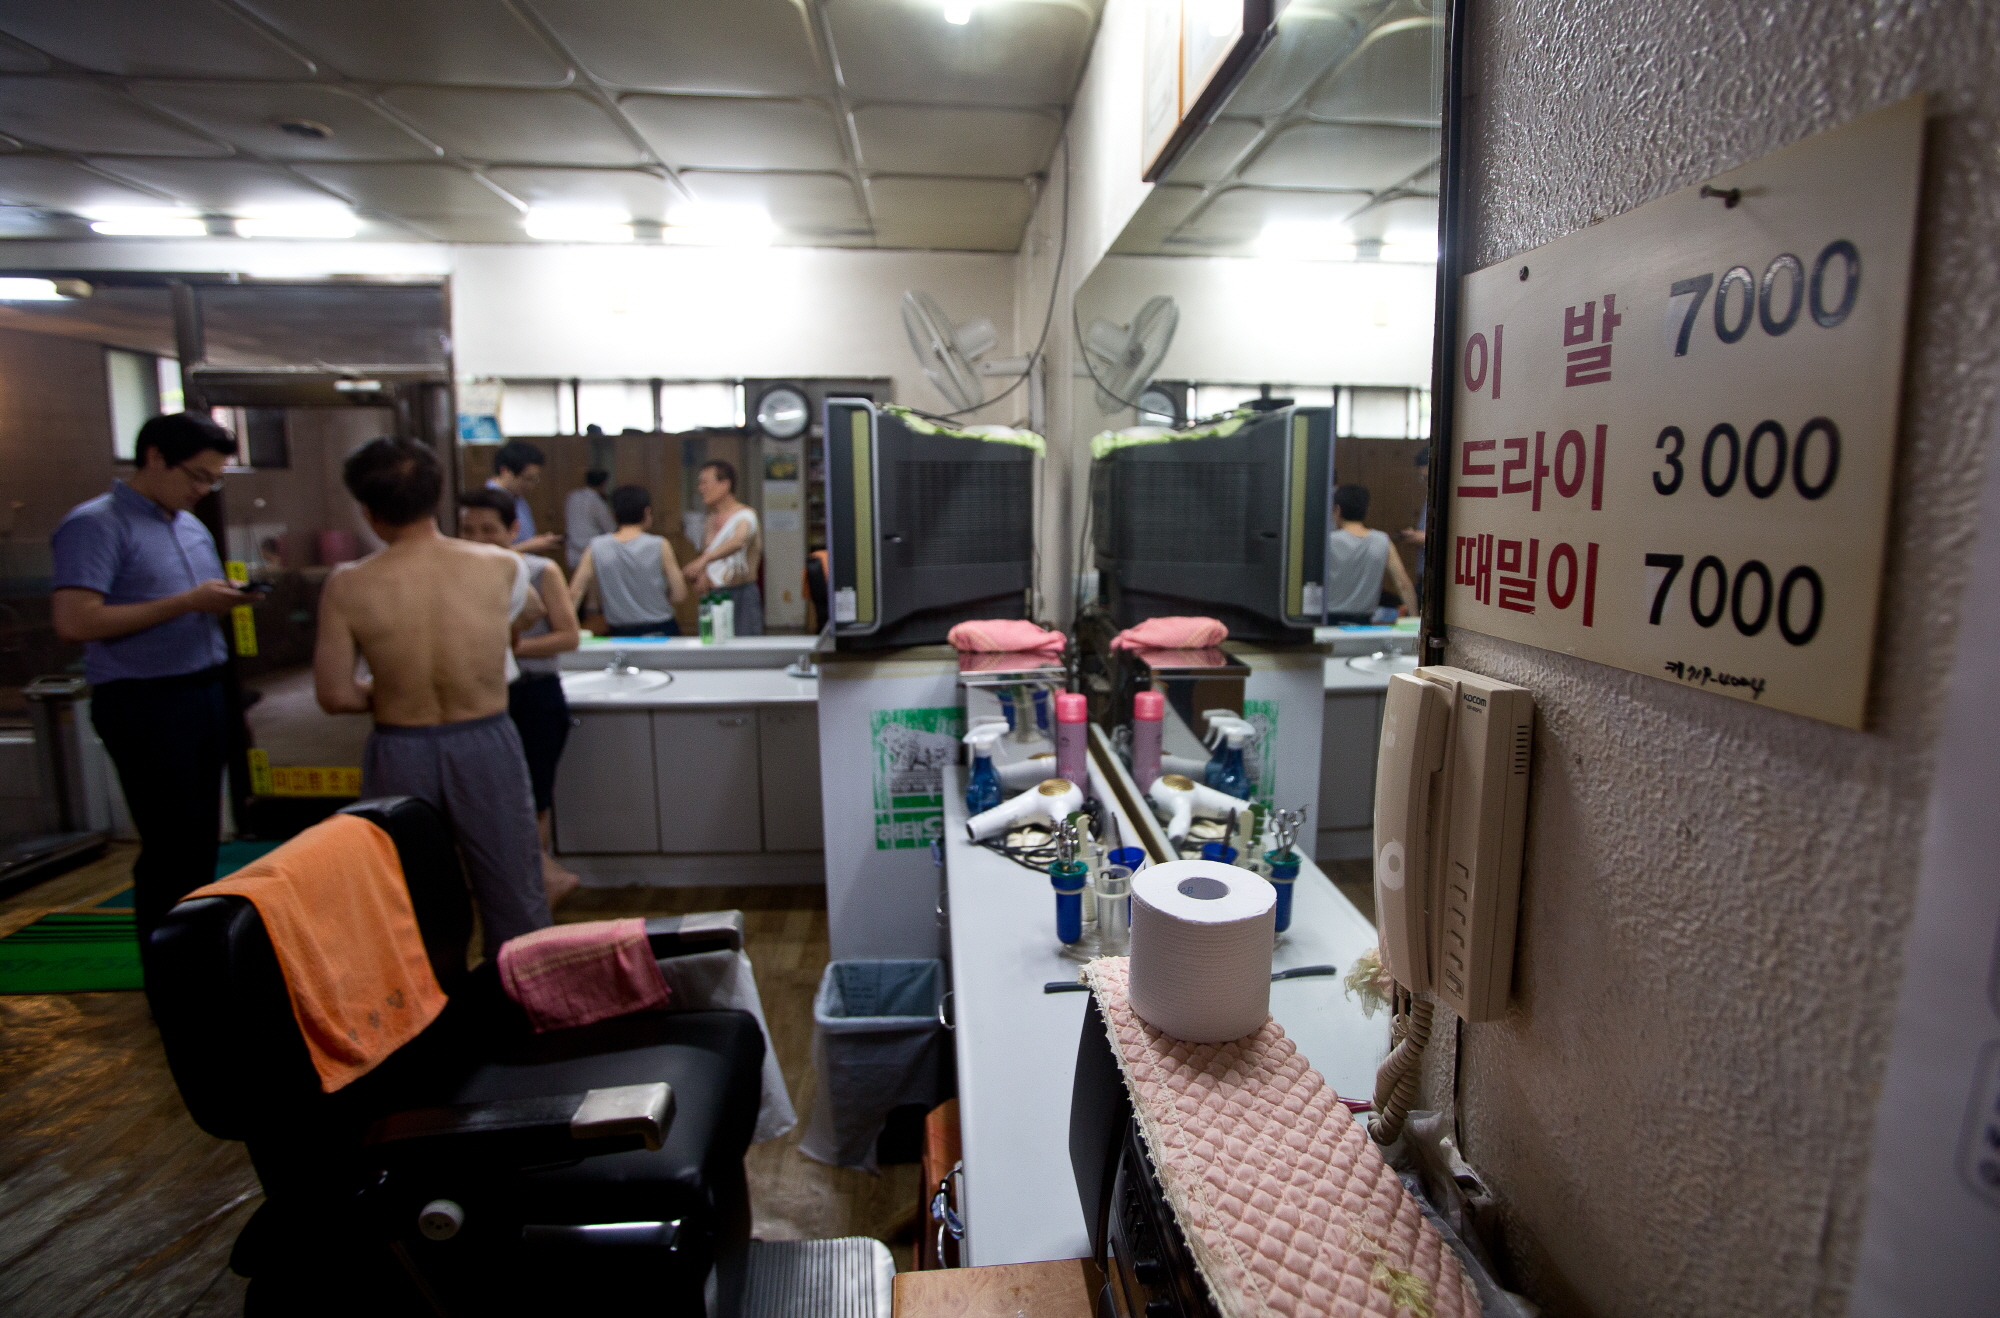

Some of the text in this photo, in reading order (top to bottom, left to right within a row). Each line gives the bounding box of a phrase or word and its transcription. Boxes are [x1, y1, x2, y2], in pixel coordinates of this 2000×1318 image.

[1670, 238, 1862, 358] 7000
[1456, 423, 1609, 512] 드라이
[1454, 532, 1824, 647] 때밀이 7000
[1463, 692, 1487, 708] KOCOM
